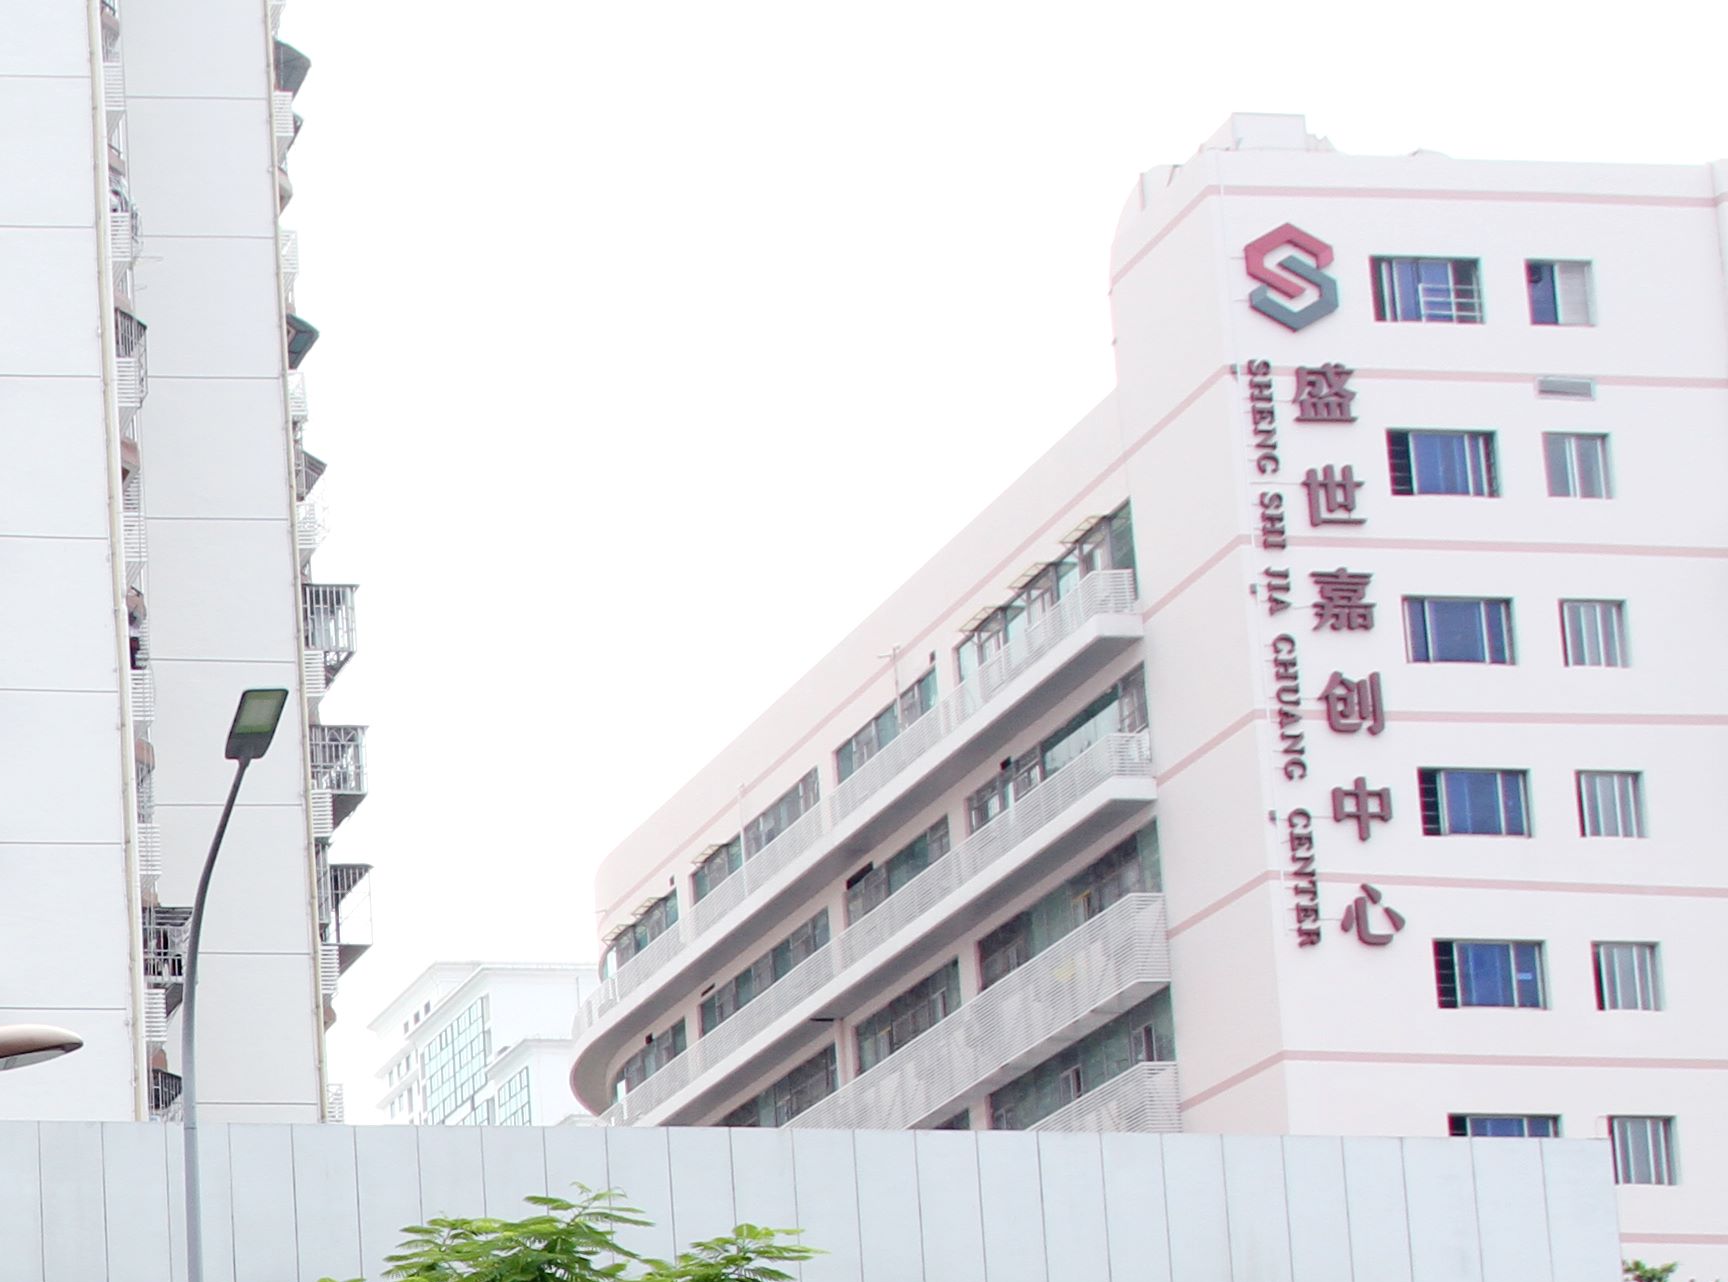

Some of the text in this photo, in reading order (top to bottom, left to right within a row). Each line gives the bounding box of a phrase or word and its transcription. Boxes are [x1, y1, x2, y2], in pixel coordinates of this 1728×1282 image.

[1247, 358, 1323, 949] SHENG SHI JIA CHUANG CENTER
[1292, 363, 1407, 947] 盛世嘉创中心
